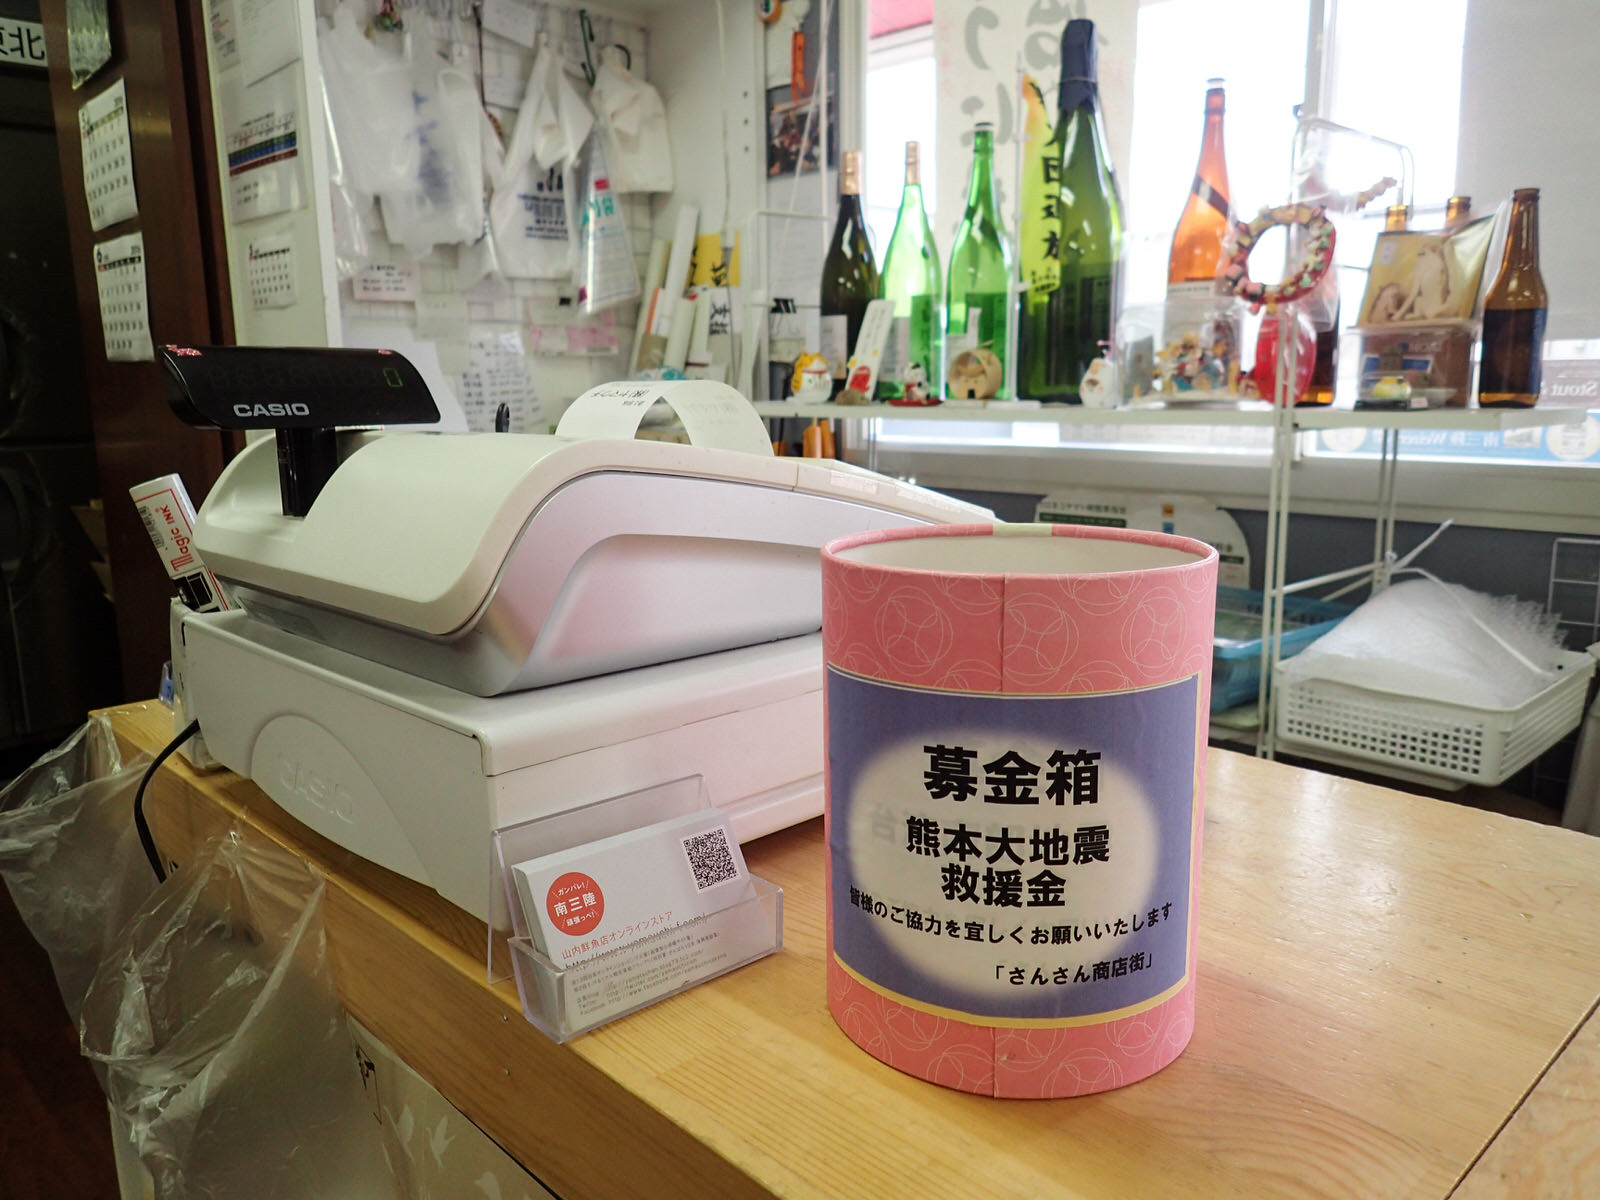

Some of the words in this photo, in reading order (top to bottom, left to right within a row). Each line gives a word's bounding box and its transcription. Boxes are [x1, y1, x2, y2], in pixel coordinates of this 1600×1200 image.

[0, 26, 46, 60] 北
[233, 402, 310, 417] CASIO
[160, 504, 176, 525] INK
[923, 744, 1102, 806] 募金箱
[905, 815, 1111, 865] 熊本大地震
[553, 892, 597, 917] 南三陸
[940, 863, 1067, 908] 救援金
[849, 884, 1173, 945] 皆様のご協力を宜しくお願いいたします
[561, 911, 673, 960] 山内鮮魚店オンラインストア
[994, 951, 1153, 986] 「さんさん商店街」
